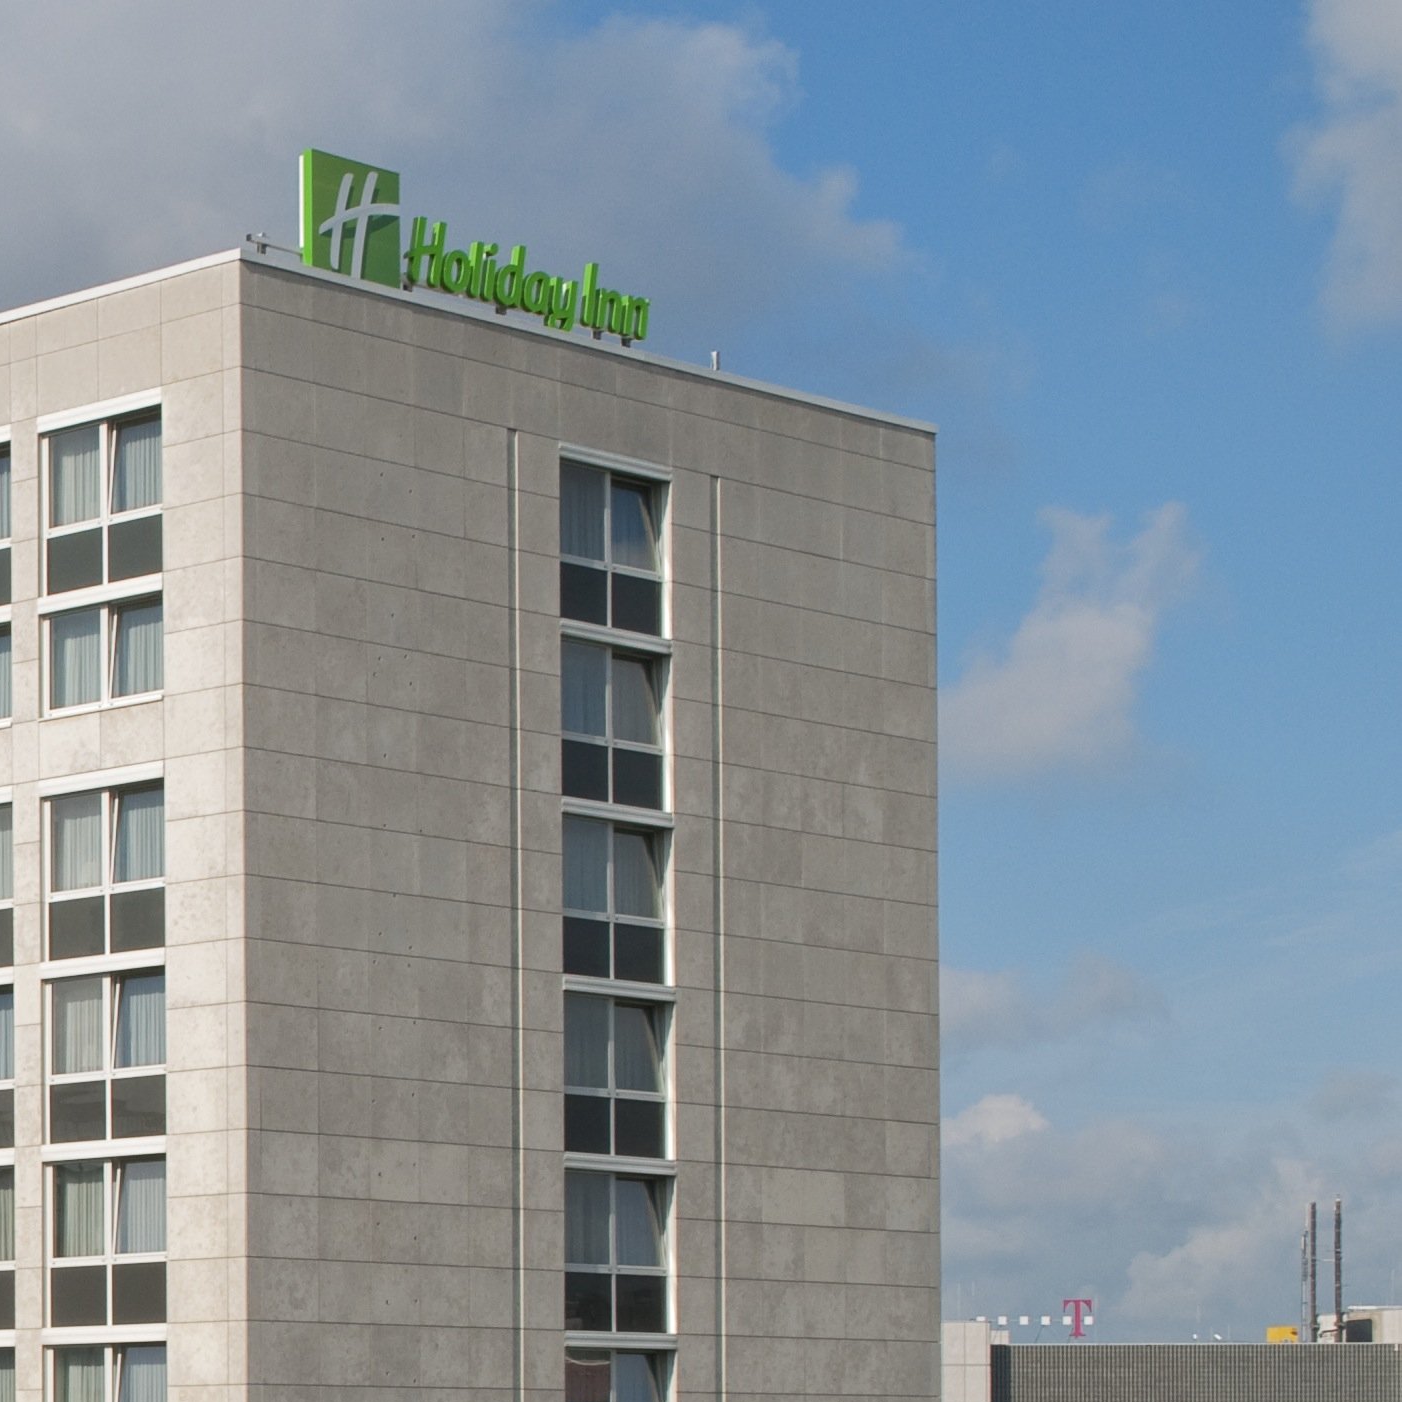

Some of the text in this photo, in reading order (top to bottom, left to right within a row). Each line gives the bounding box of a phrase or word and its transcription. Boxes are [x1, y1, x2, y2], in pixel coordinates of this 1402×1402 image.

[404, 216, 650, 341] Holiday Inn
[1062, 1298, 1092, 1338] T
